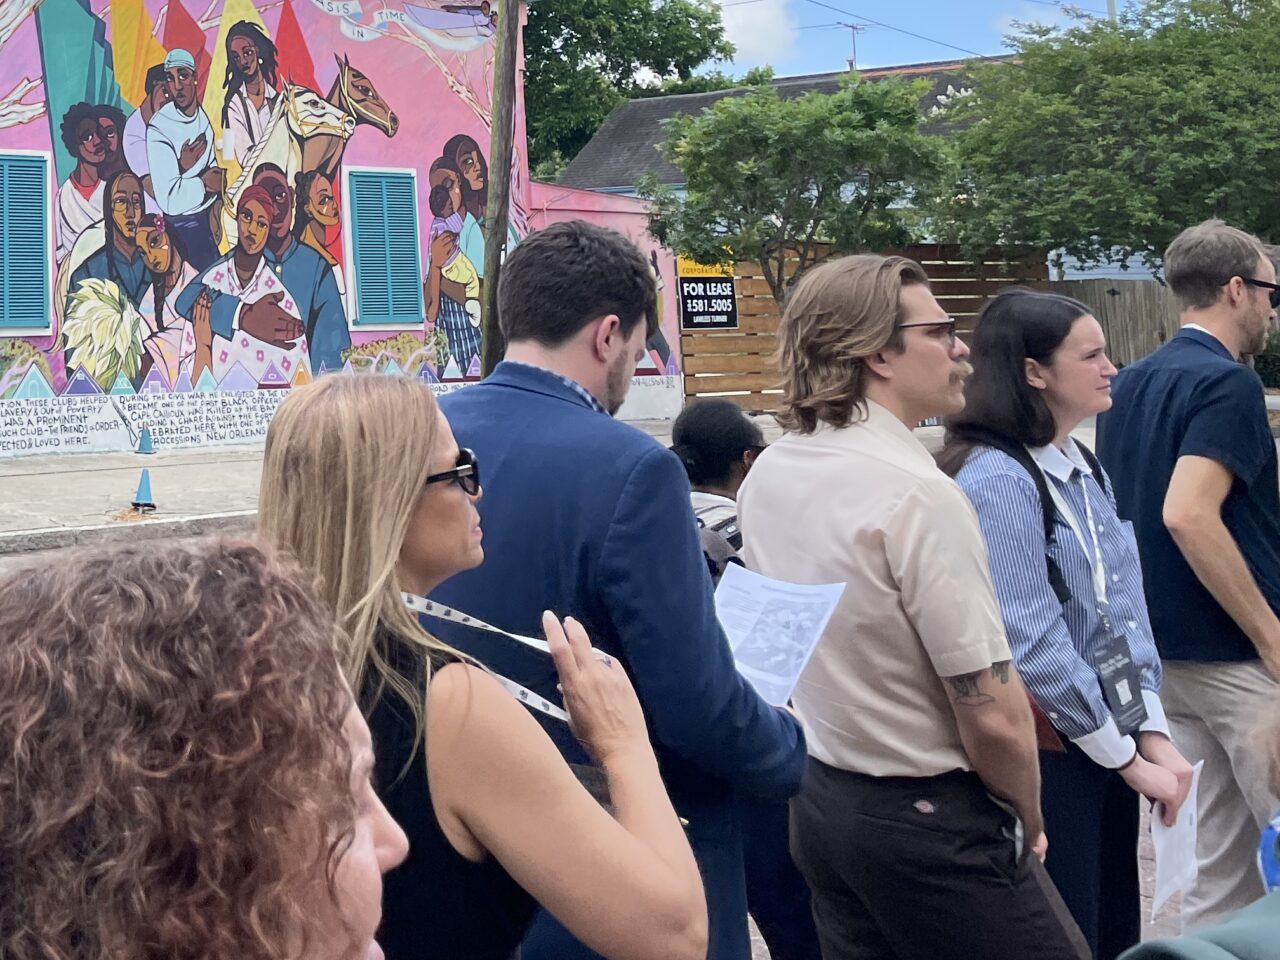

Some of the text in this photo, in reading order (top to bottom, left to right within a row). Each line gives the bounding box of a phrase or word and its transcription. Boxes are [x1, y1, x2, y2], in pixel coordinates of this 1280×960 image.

[352, 27, 364, 39] IN
[377, 11, 405, 22] TIME
[683, 282, 733, 296] FOR LEASE
[692, 299, 732, 312] 581.5005
[25, 398, 48, 407] THESE
[51, 397, 78, 406] CLUBS
[80, 396, 109, 405] HELPED
[119, 394, 149, 404] DURING
[188, 391, 206, 400] WAR
[221, 398, 248, 407] BLACK
[188, 407, 204, 415] WAS
[4, 418, 24, 427] WAS
[27, 418, 34, 427] A
[36, 415, 89, 425] PROMINENT
[194, 423, 216, 432] HERE
[240, 420, 254, 428] ONE
[206, 432, 226, 441] NEW
[229, 427, 266, 439] ORLEANS
